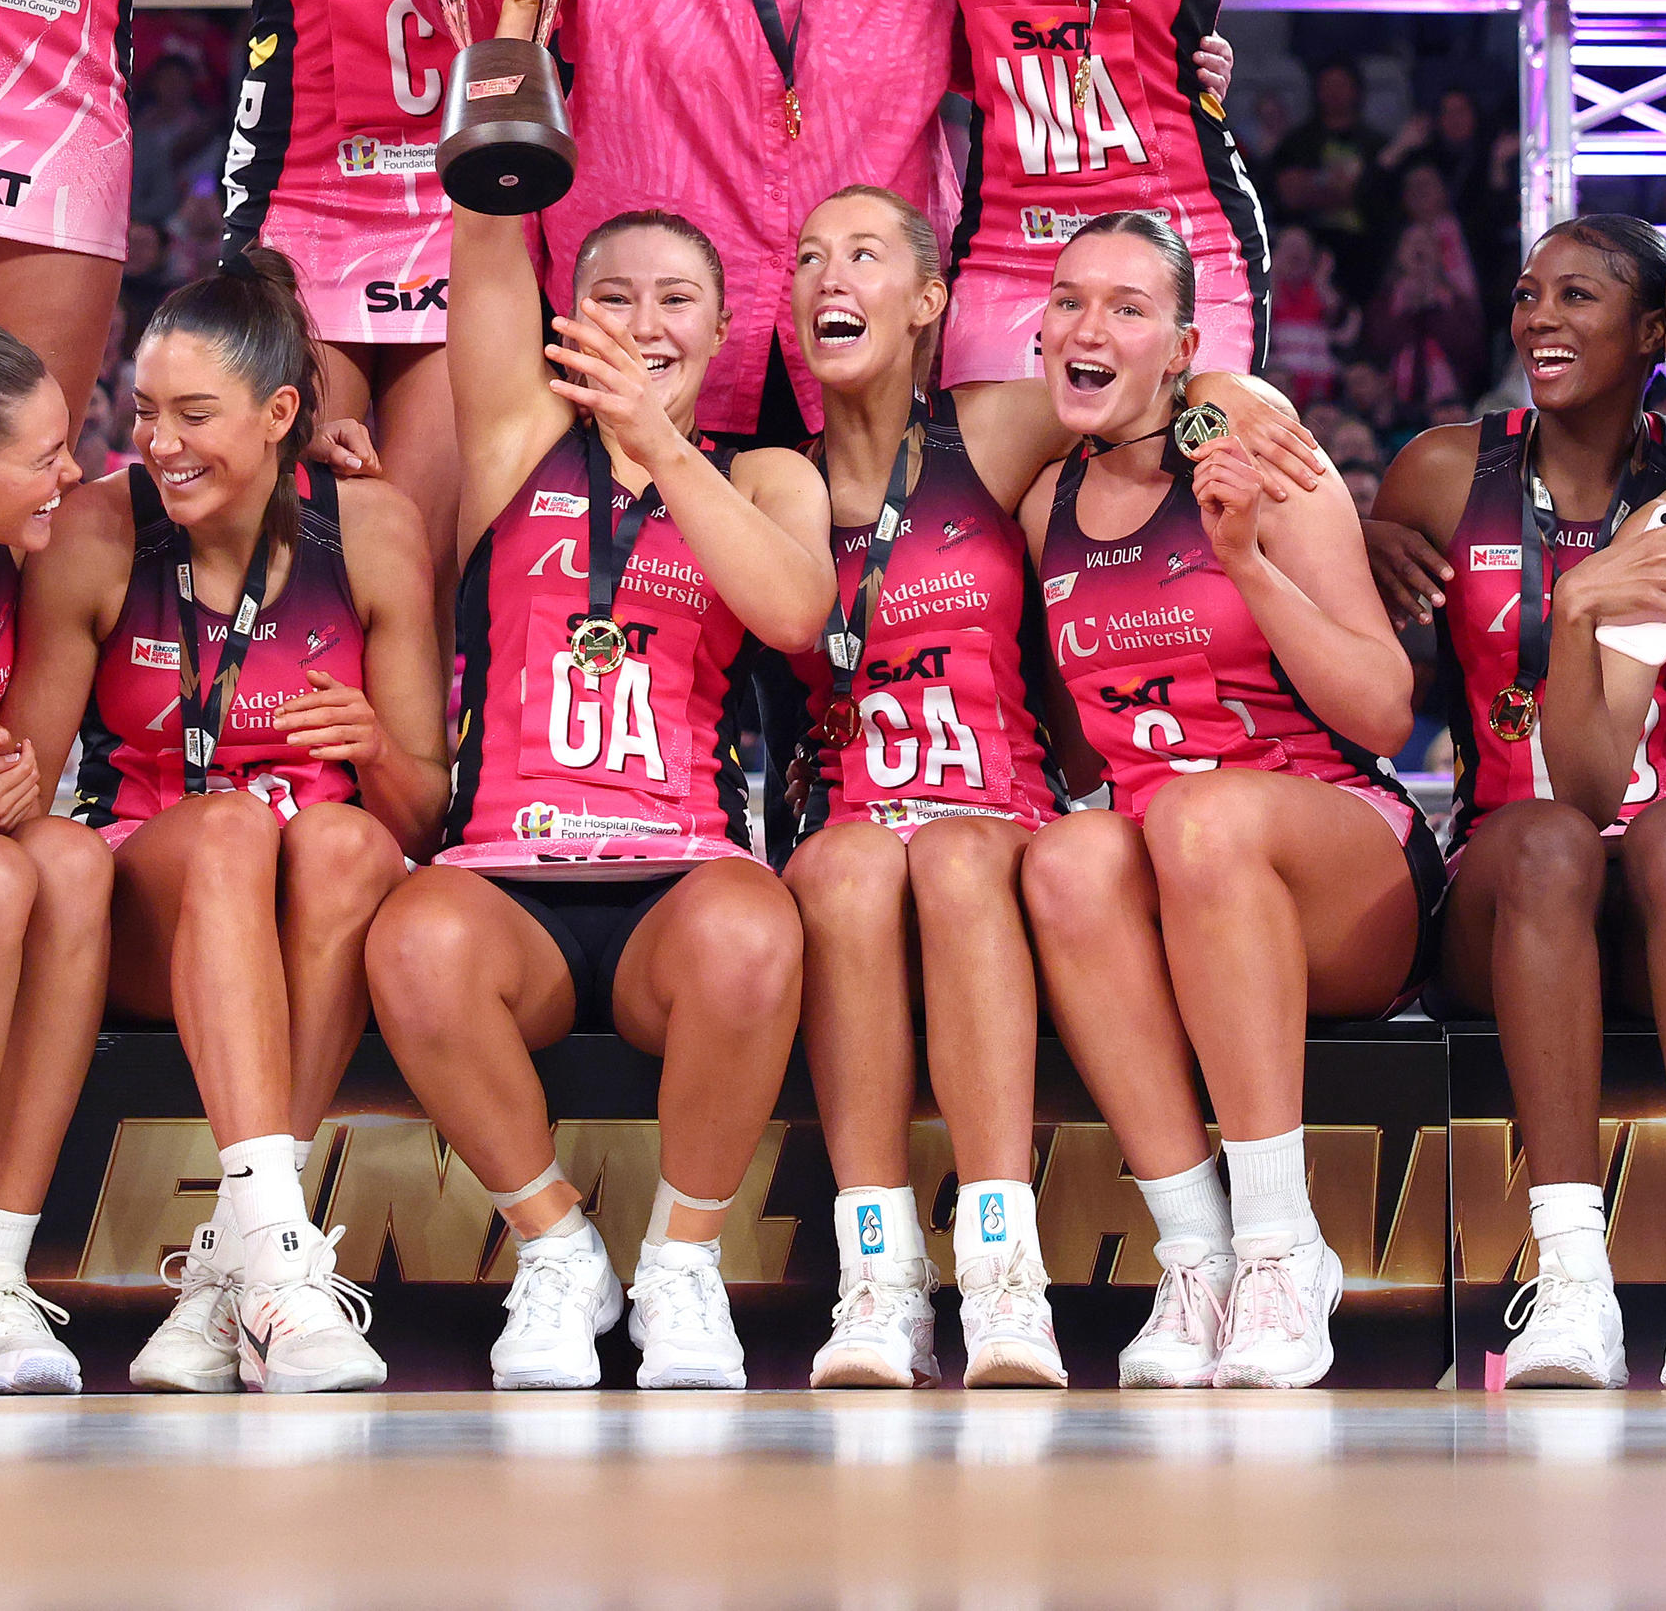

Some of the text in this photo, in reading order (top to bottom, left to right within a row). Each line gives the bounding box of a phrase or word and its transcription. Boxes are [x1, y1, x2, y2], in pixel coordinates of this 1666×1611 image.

[28, 0, 57, 15] Group
[996, 55, 1147, 174] WA
[384, 149, 402, 158] The
[625, 555, 704, 586] delaide
[1086, 546, 1142, 568] VALOUR
[620, 575, 713, 614] niversity
[879, 570, 975, 608] Adelaide
[881, 590, 990, 626] University
[1106, 606, 1195, 631] Adelaide
[1106, 626, 1213, 651] University
[549, 651, 666, 781] GA
[562, 818, 678, 835] The Hospital Research
[917, 808, 976, 819] Foundation
[72, 1118, 802, 1284] FNAL
